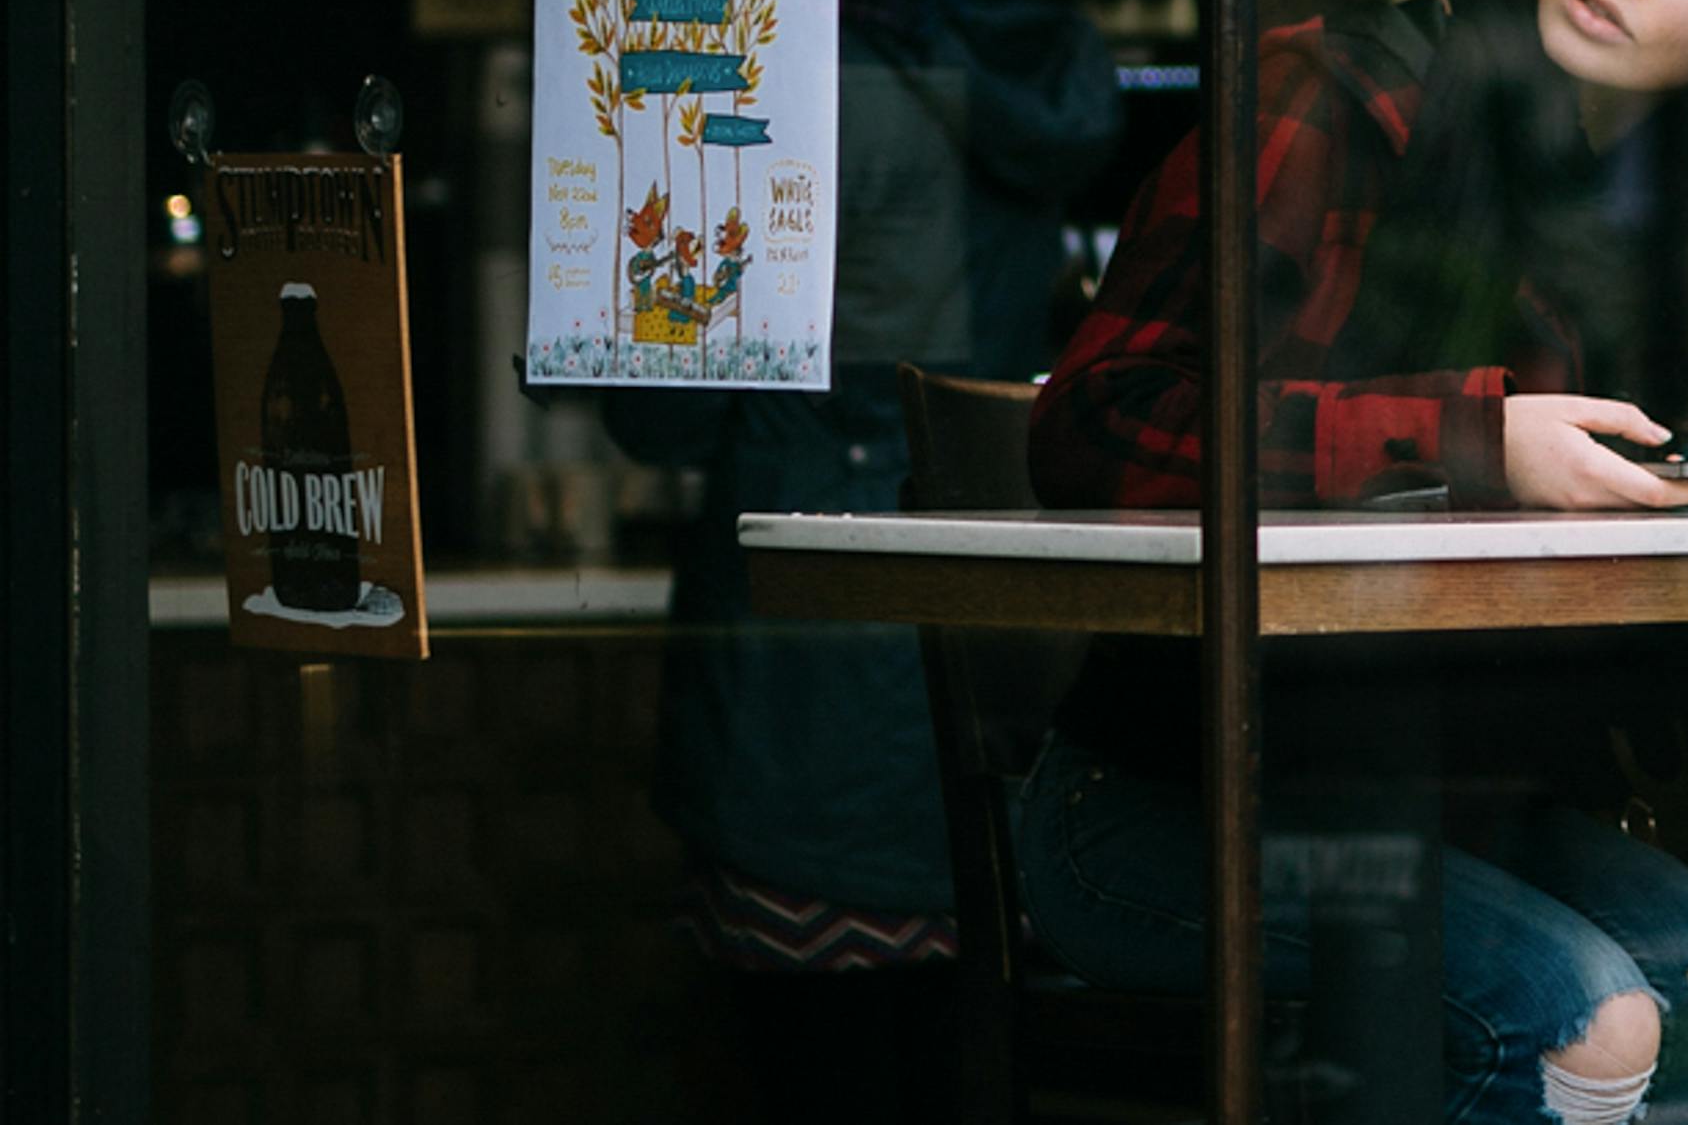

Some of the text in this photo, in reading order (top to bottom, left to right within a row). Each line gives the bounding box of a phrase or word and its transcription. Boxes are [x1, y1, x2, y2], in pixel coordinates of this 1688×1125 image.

[216, 166, 386, 264] STUMPTOWN
[235, 459, 385, 545] COLD BREW
